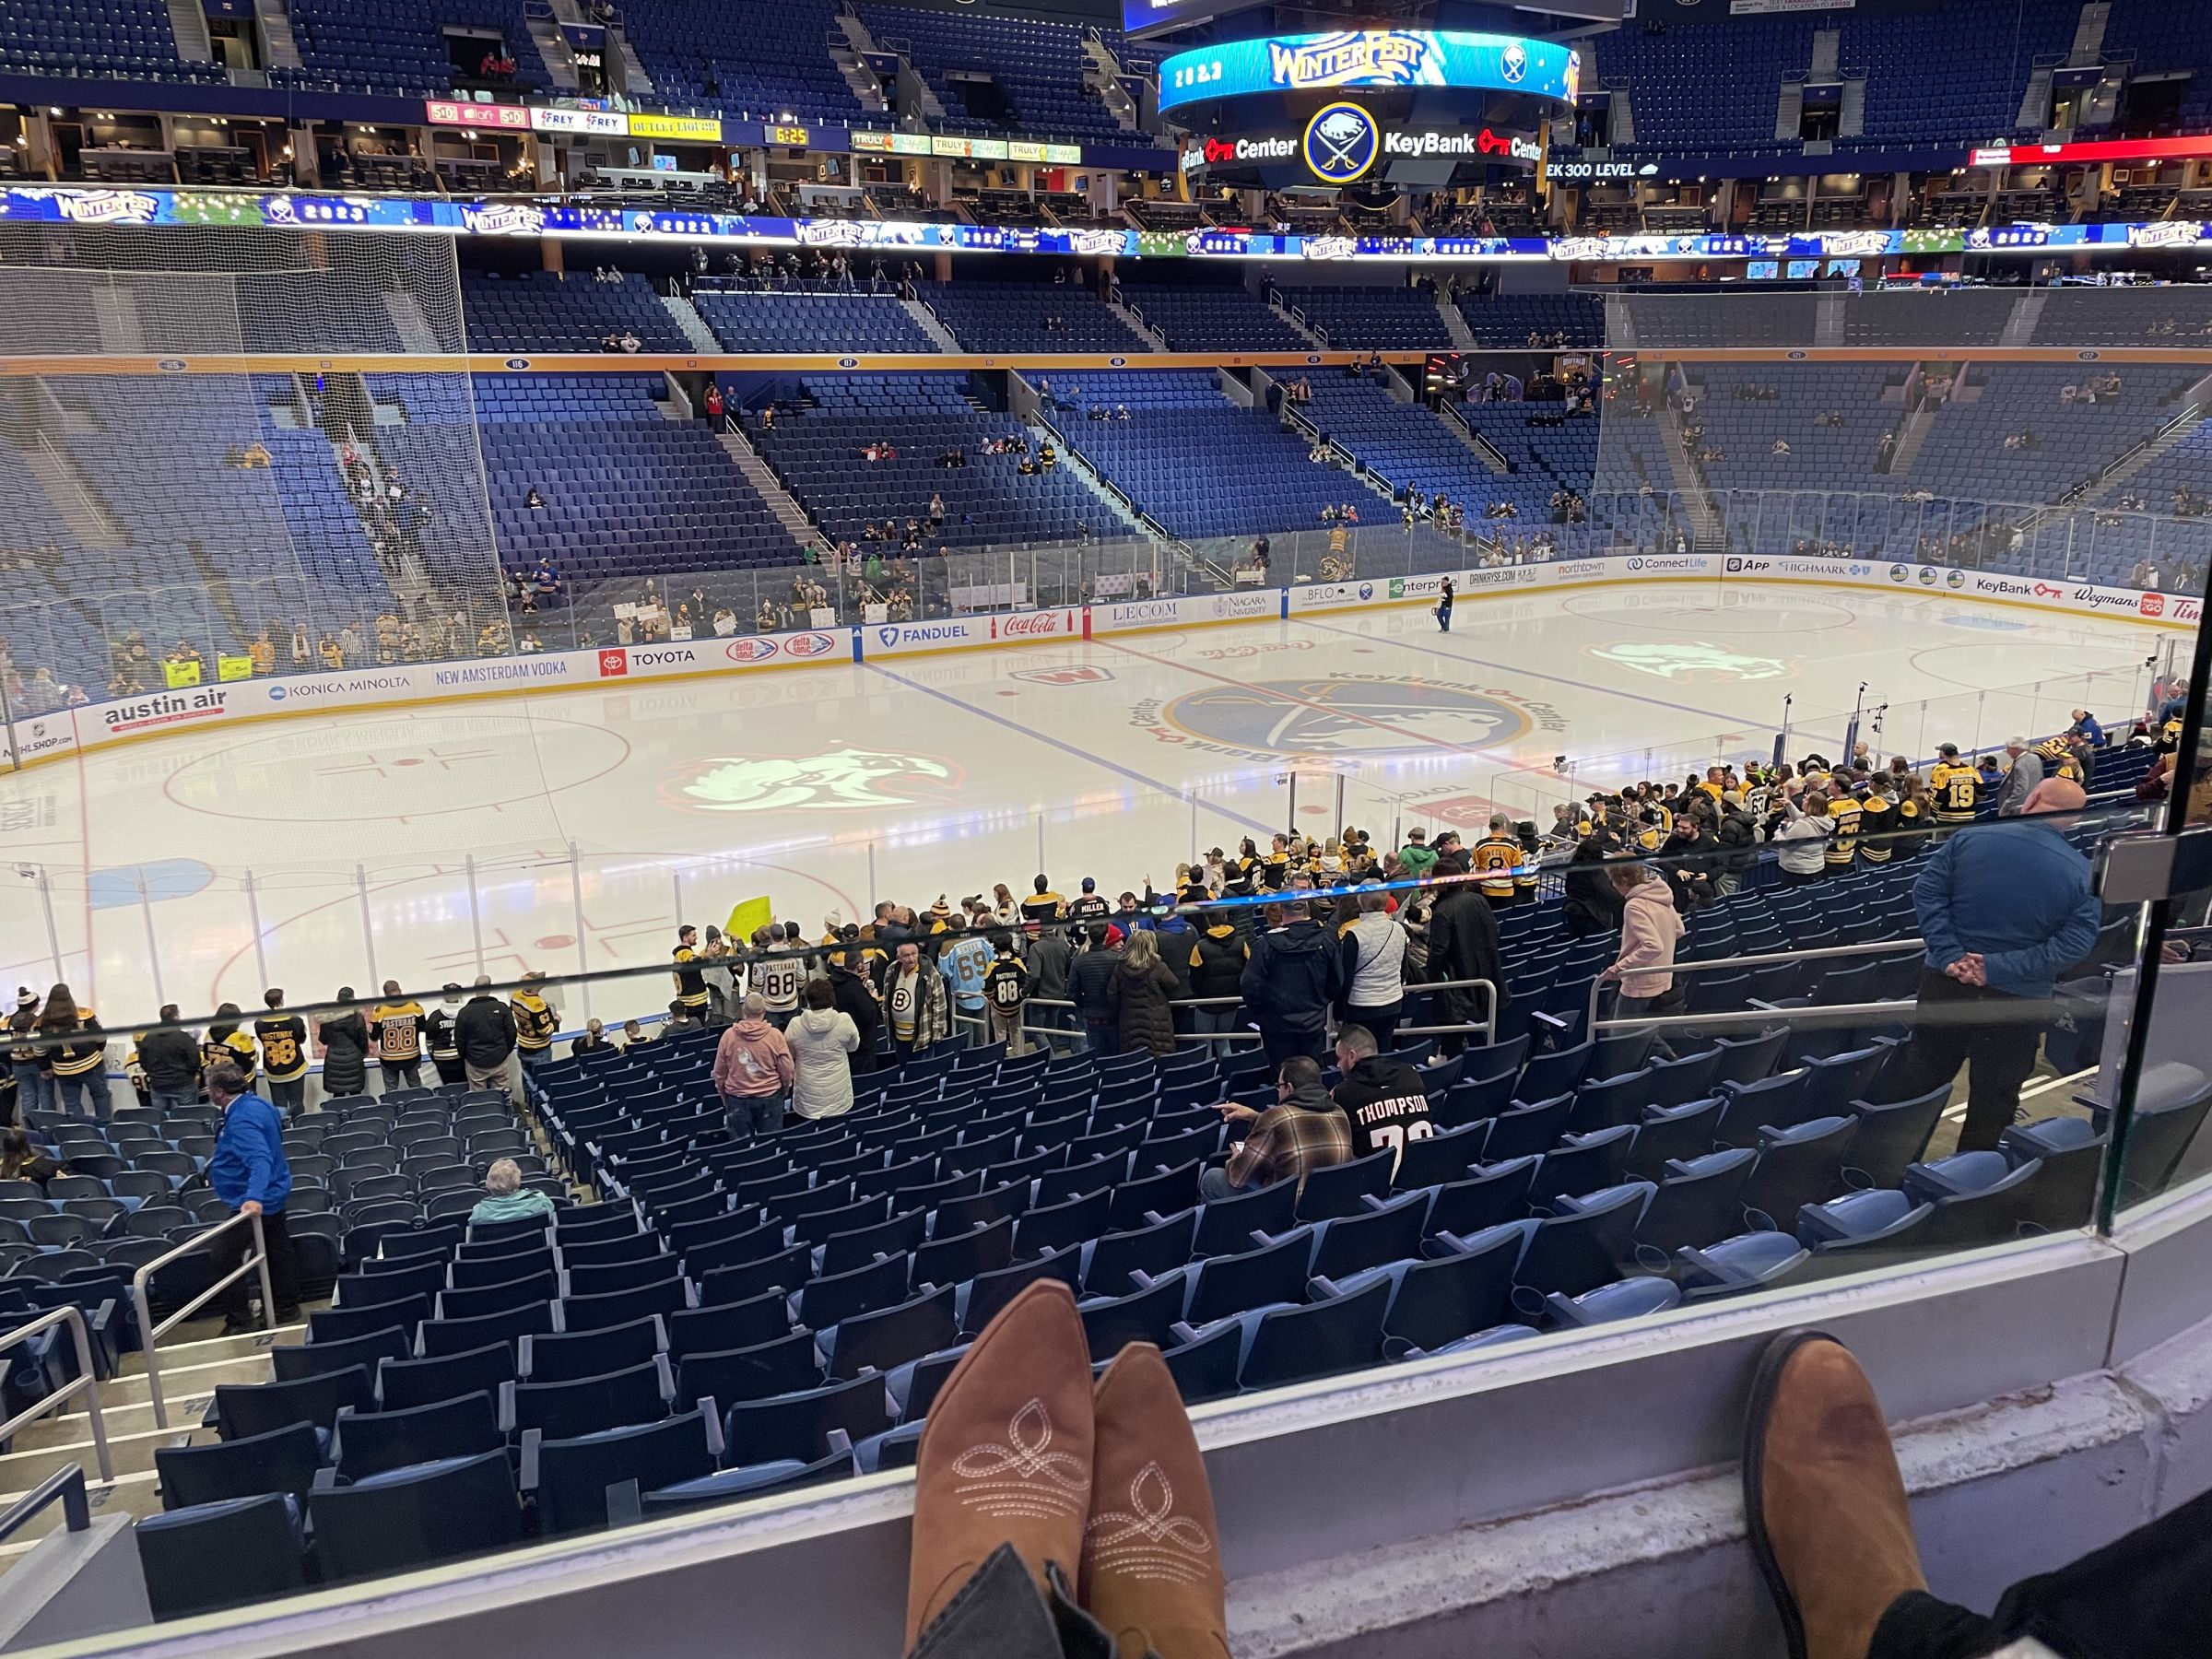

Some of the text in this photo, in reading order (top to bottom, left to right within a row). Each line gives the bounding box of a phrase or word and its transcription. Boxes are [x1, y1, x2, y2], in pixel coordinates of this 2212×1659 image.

[546, 113, 574, 125] FREY
[591, 117, 618, 128] FREY
[777, 127, 806, 141] 6:25
[853, 134, 884, 145] TRULY
[935, 140, 964, 150] TRULY
[1013, 145, 1038, 155] TRULY
[1235, 137, 1298, 159] Center
[1384, 132, 1543, 161] KeyBank Center
[1565, 164, 1592, 178] 300
[1595, 164, 1636, 177] LEVEL
[1563, 358, 1586, 366] BUFFALO
[1559, 562, 1605, 574] northtown
[1784, 563, 1846, 576] HIGHMARK
[1394, 579, 1458, 593] enterpre
[1977, 579, 2031, 595] KeyBank
[1308, 587, 1335, 601] BFLO
[2073, 586, 2139, 608] Wegmans
[1112, 602, 1178, 621] LECOM
[2142, 604, 2162, 614] 2GO
[793, 636, 811, 645] delta
[903, 626, 969, 642] FANDUEL
[735, 641, 754, 652] delta
[736, 648, 755, 659] sonic
[793, 644, 812, 654] sonic
[632, 650, 695, 666] TOYOTA
[436, 661, 567, 686] NEW AMSTERDAM VODKA
[289, 677, 410, 697] KONICA MINOLTA
[105, 695, 187, 724] austin
[194, 688, 227, 709] air
[1329, 671, 1571, 734] KeyBank Center
[1128, 697, 1164, 728] Center
[1948, 785, 1974, 807] 19
[1752, 794, 1765, 815] 63
[1081, 902, 1104, 913] MILLER
[766, 961, 795, 971] PASTRNAK
[957, 950, 987, 982] 69
[767, 972, 794, 996] 88
[997, 981, 1018, 1004] 88
[382, 1017, 417, 1029] PASTRNAK
[382, 1025, 417, 1051] 88
[263, 1039, 296, 1066] 88
[1357, 1095, 1429, 1125] THOMPSON
